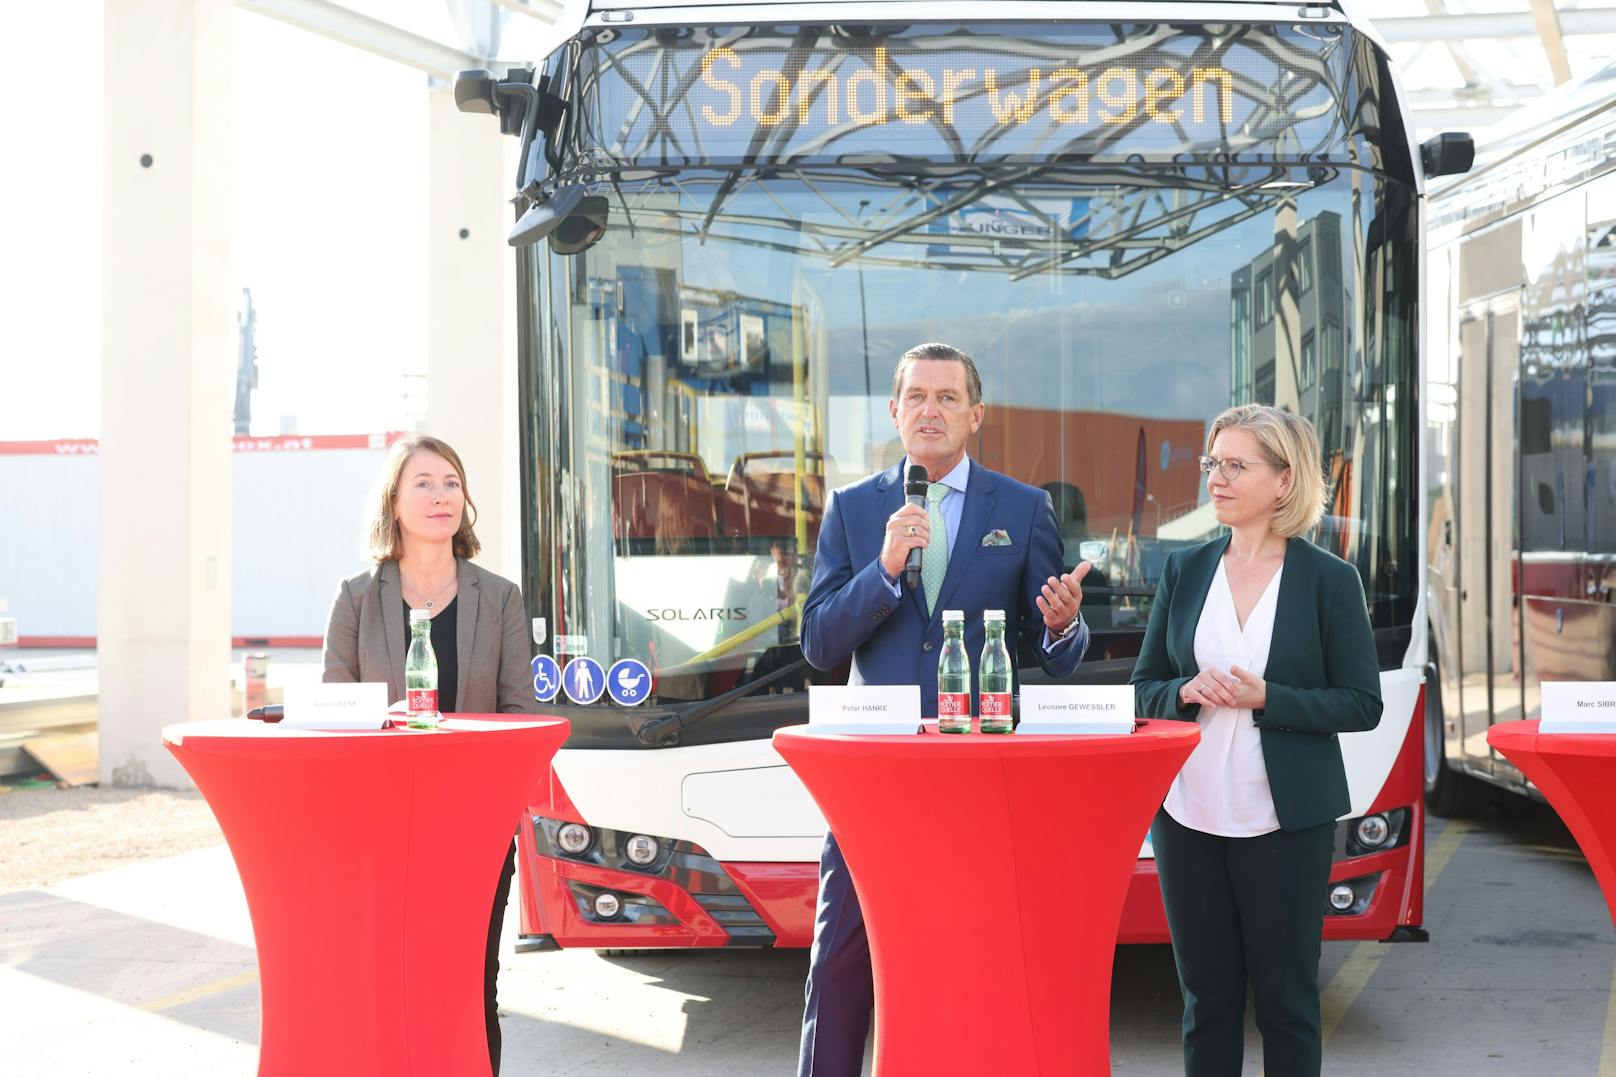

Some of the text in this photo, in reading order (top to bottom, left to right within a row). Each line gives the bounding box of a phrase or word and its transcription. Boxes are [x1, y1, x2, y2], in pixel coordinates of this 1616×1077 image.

[701, 46, 1234, 126] Sonderwagen
[53, 437, 312, 455] ww ox.at
[646, 607, 748, 621] SOLARIS
[842, 704, 888, 712] Peter HANKE
[1038, 703, 1117, 711] Leonore GEWESSLER
[1576, 700, 1595, 708] Marc
